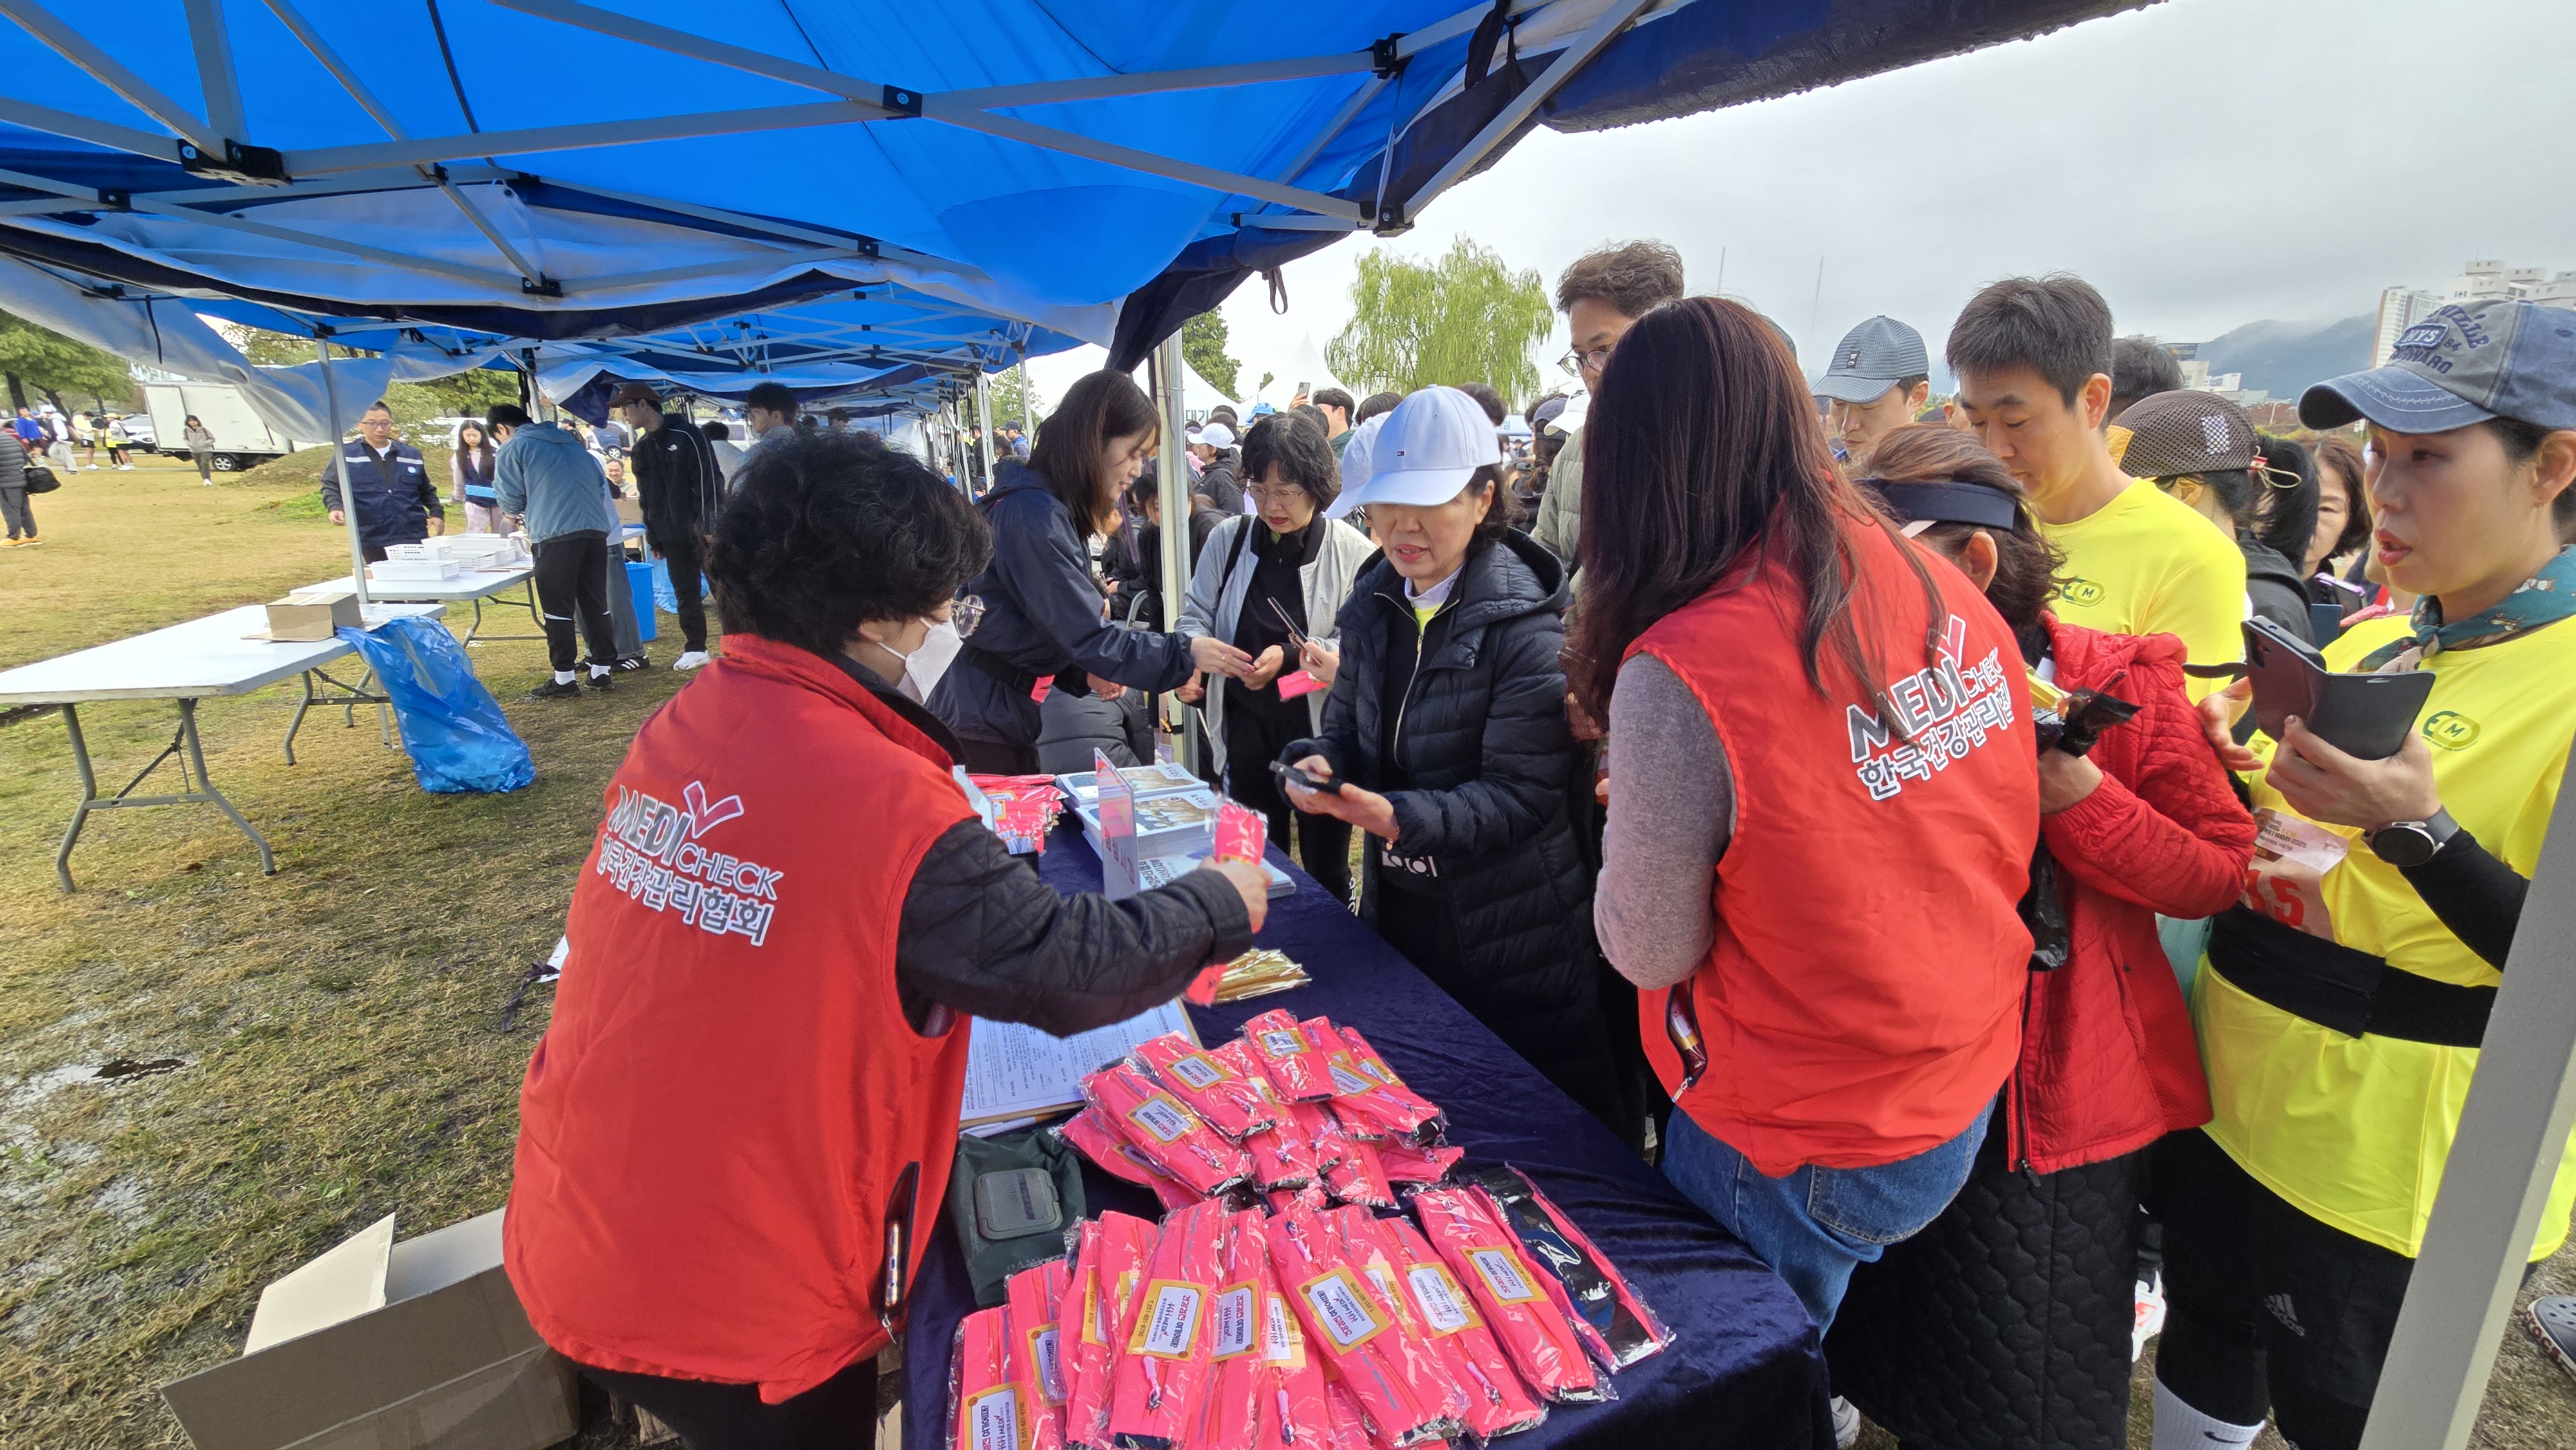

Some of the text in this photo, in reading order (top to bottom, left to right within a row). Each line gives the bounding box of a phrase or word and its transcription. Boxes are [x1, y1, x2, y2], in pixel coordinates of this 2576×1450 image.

[2401, 329, 2439, 343] NYS
[1846, 657, 1969, 763] MEDI
[608, 784, 692, 866] MEDI
[596, 832, 775, 947] 한국건강관리협회
[676, 842, 784, 901] CHECK
[1164, 1301, 1176, 1317] KH
[1177, 1293, 1191, 1322] 건강검진
[1223, 1305, 1232, 1321] KH
[1316, 1288, 1353, 1338] 건강검진 여기어때?
[1337, 1297, 1359, 1324] KH MEDI
[1349, 1281, 1376, 1313] T.051-601-9700
[1137, 1299, 1154, 1337] T.051-601-9700
[1160, 1315, 1170, 1333] MEDI
[2264, 1297, 2306, 1337] adidas
[981, 1404, 990, 1438] 여기어때?
[1019, 1401, 1028, 1444] T.051-601-9700
